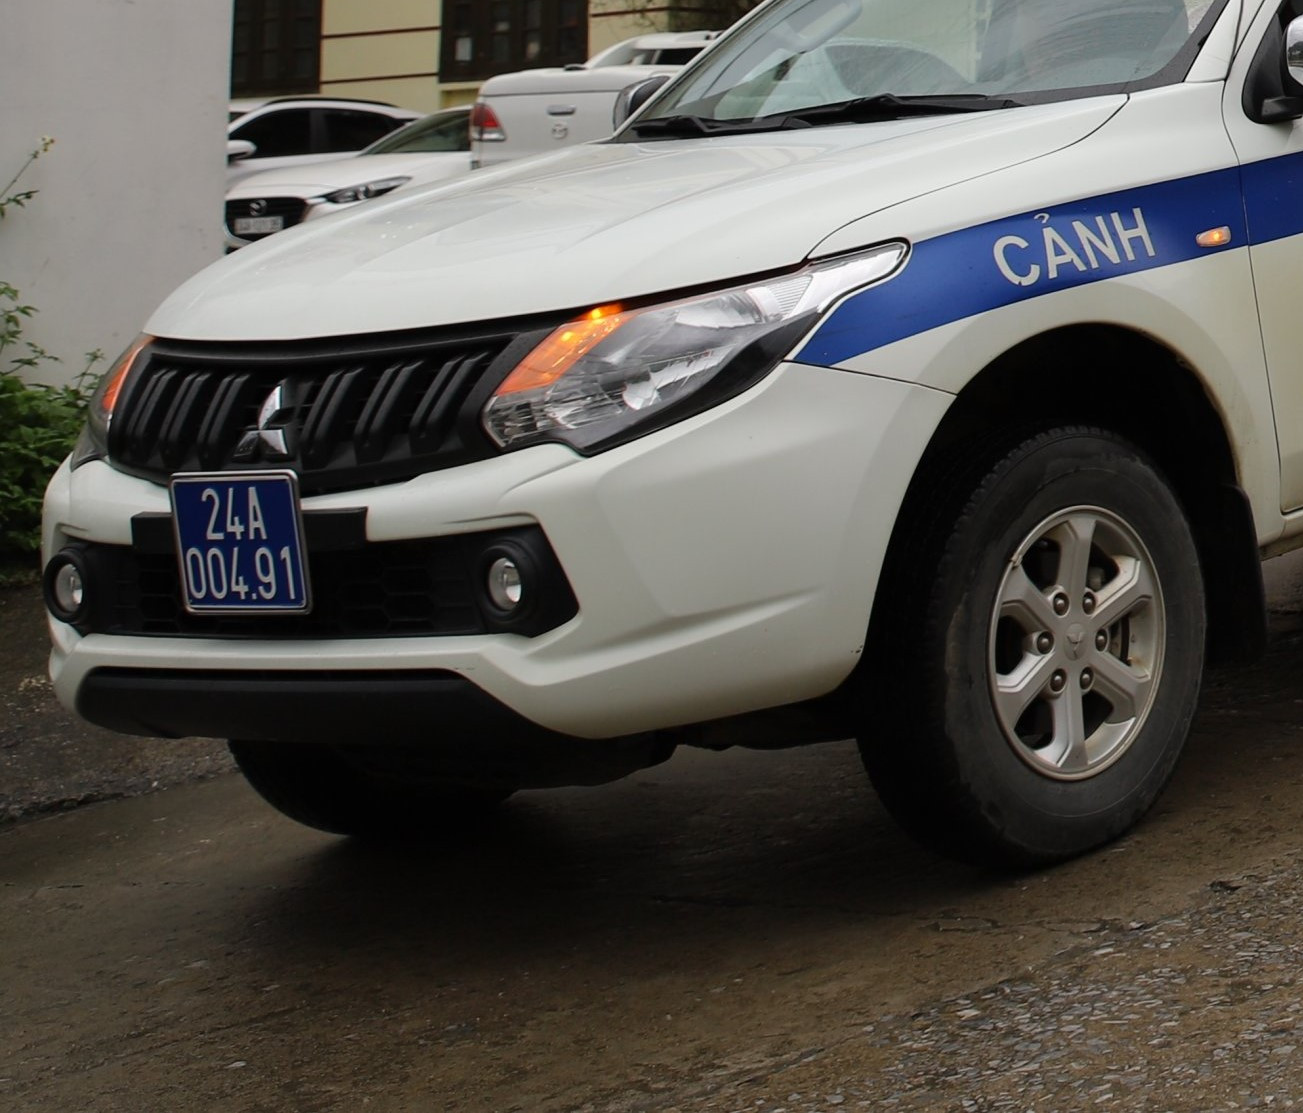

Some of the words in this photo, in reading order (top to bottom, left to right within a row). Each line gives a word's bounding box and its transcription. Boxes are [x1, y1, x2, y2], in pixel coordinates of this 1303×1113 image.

[992, 205, 1157, 287] CẢNH
[201, 486, 268, 541] 24A
[186, 546, 296, 600] 004.91
